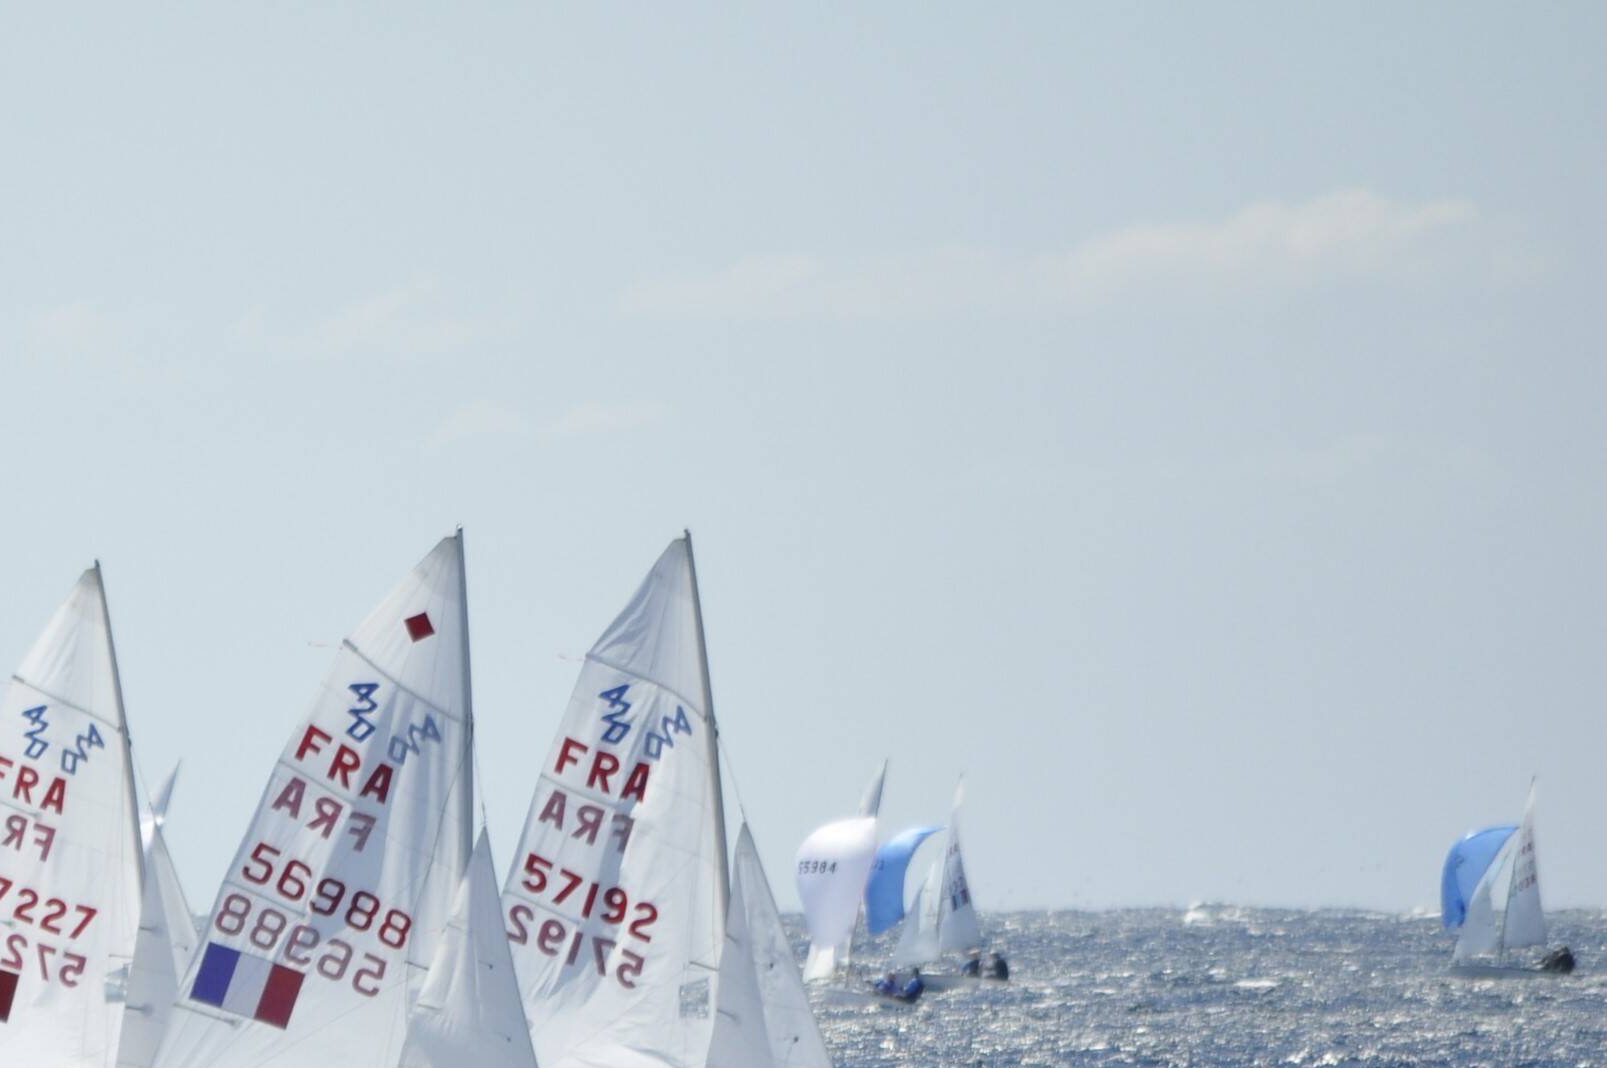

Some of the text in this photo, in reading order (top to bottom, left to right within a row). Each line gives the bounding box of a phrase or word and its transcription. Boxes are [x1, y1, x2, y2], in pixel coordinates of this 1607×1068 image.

[294, 724, 395, 805] FRA
[553, 736, 652, 803] FRA
[241, 841, 413, 951] 56988
[522, 852, 660, 944] 57192
